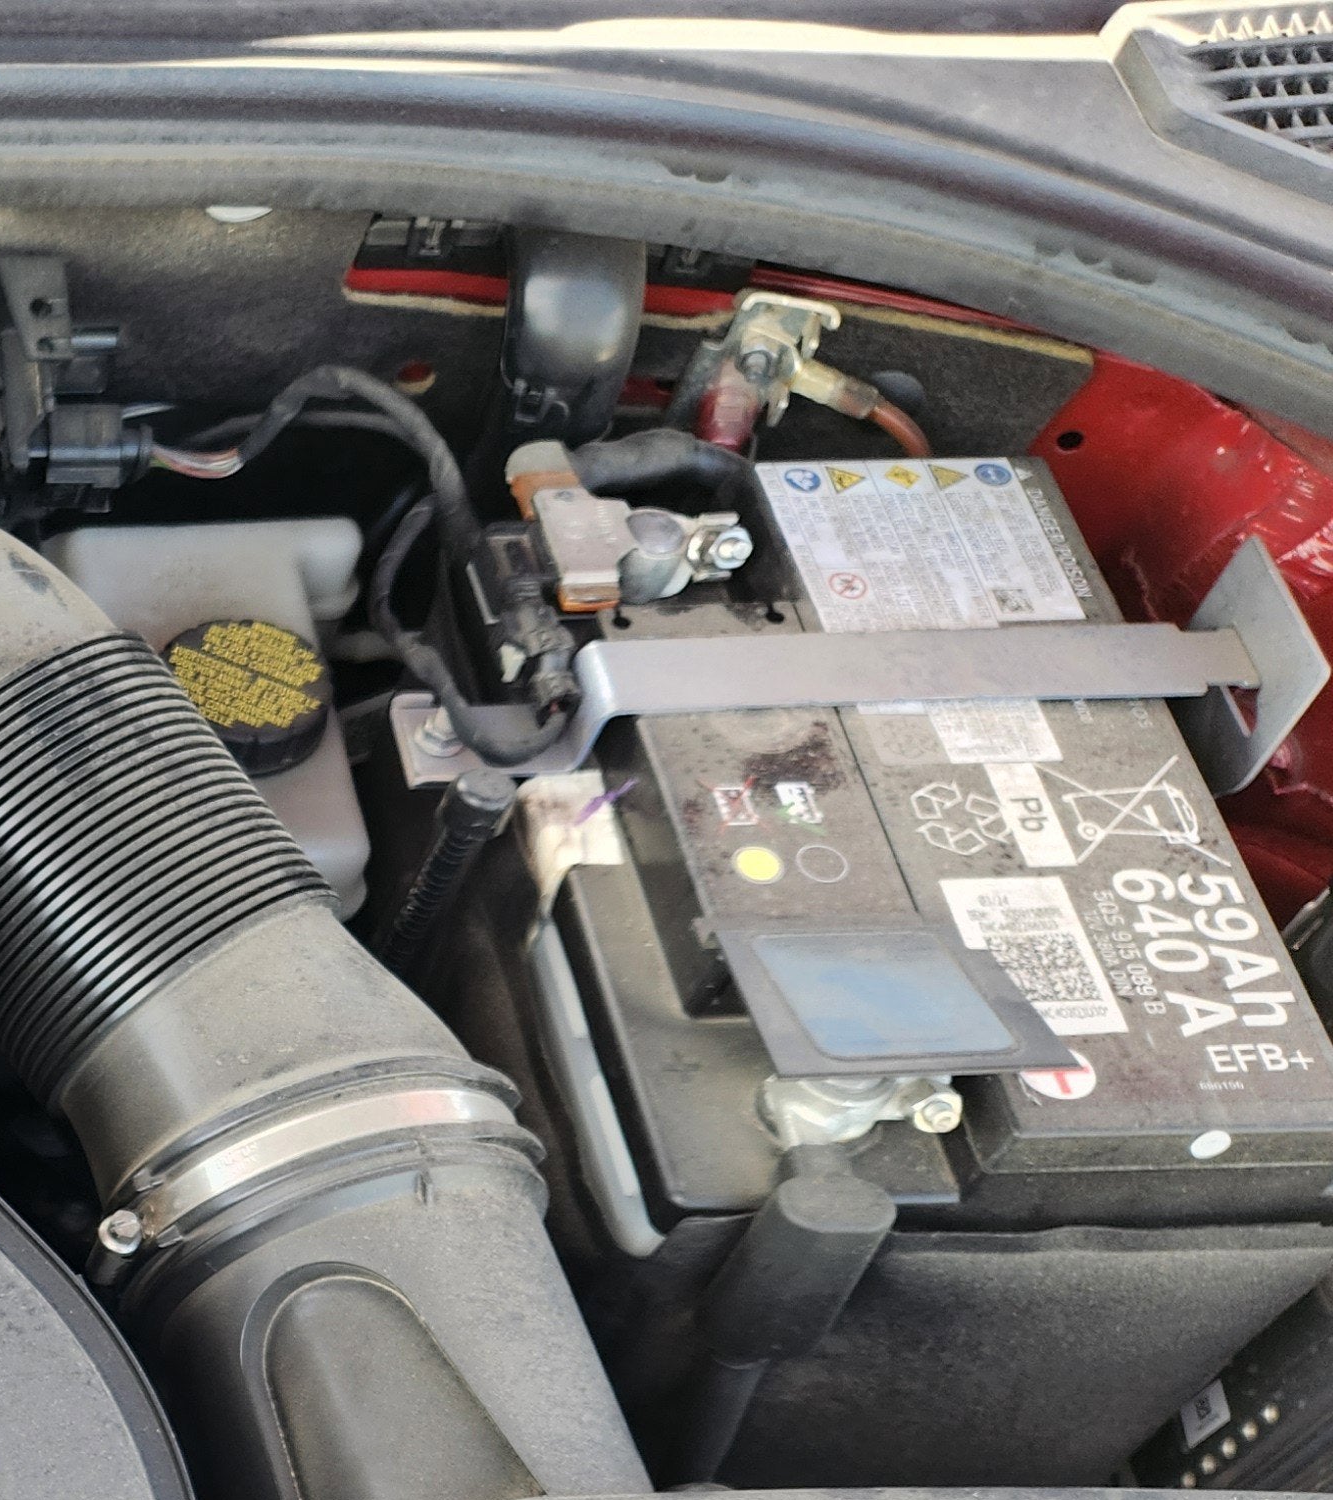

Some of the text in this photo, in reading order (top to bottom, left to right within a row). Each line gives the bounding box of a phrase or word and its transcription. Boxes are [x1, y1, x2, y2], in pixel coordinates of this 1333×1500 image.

[1010, 797, 1048, 833] Pb
[1112, 868, 1210, 973] 640
[1164, 990, 1238, 1038] A
[1112, 930, 1142, 959] 915
[1143, 1001, 1167, 1016] B
[1177, 872, 1296, 1028] 59Ah
[1206, 1042, 1315, 1074] EFB+
